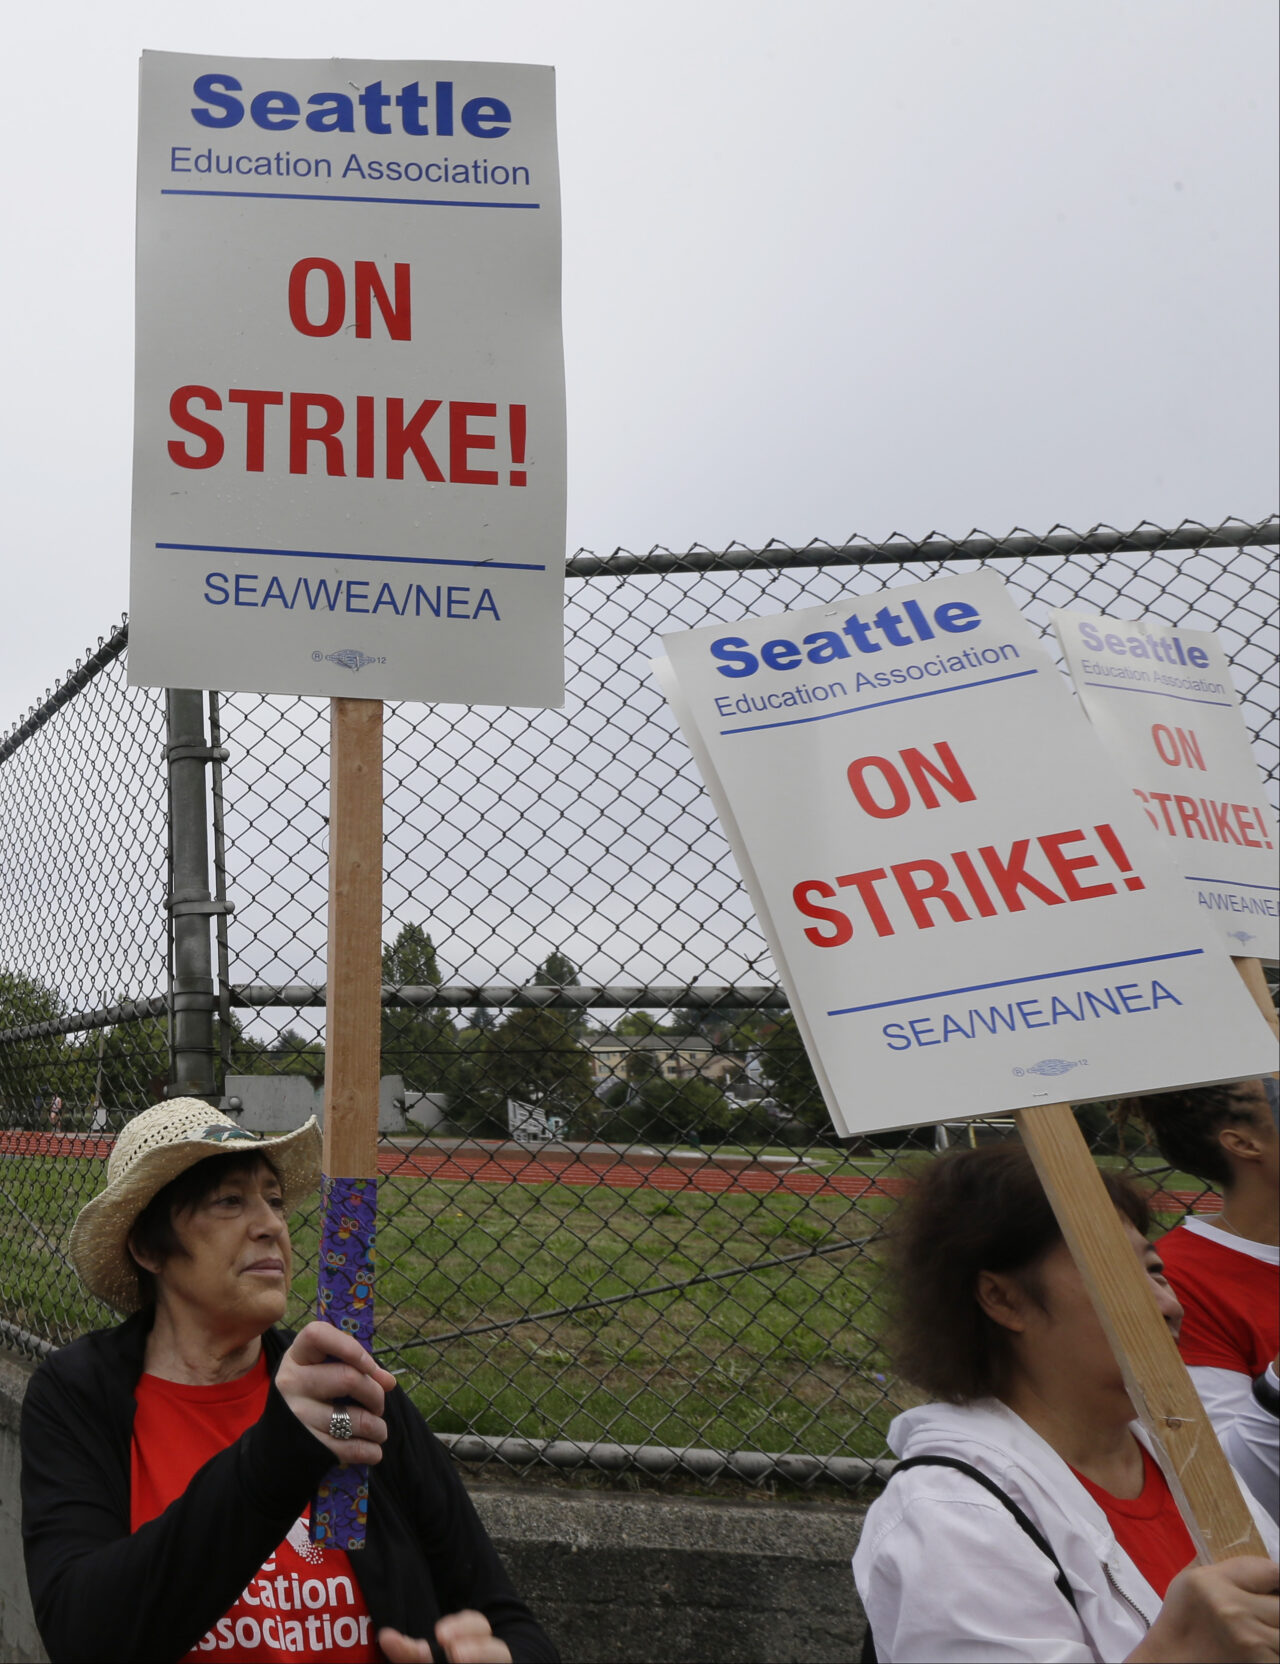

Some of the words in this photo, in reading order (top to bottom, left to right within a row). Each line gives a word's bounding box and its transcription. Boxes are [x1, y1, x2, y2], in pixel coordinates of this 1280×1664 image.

[191, 73, 511, 139] Seattle
[170, 147, 331, 178] Education
[342, 153, 530, 186] Association
[288, 257, 411, 341] ON
[167, 384, 527, 487] STRIKE!
[203, 572, 501, 621] SEA/WEA/NEA
[709, 598, 982, 679] Seattle
[1078, 622, 1210, 669] Seattle
[713, 676, 848, 718] Education
[854, 640, 1020, 695] Association
[1081, 660, 1150, 683] Education
[1153, 672, 1225, 694] Association
[846, 740, 978, 820] ON
[1151, 723, 1207, 771] ON
[791, 823, 1146, 948] STRIKE!
[1198, 891, 1279, 917] A/WEA/NE
[881, 979, 1183, 1052] SEA/WEA/NEA
[234, 1572, 354, 1610] cation
